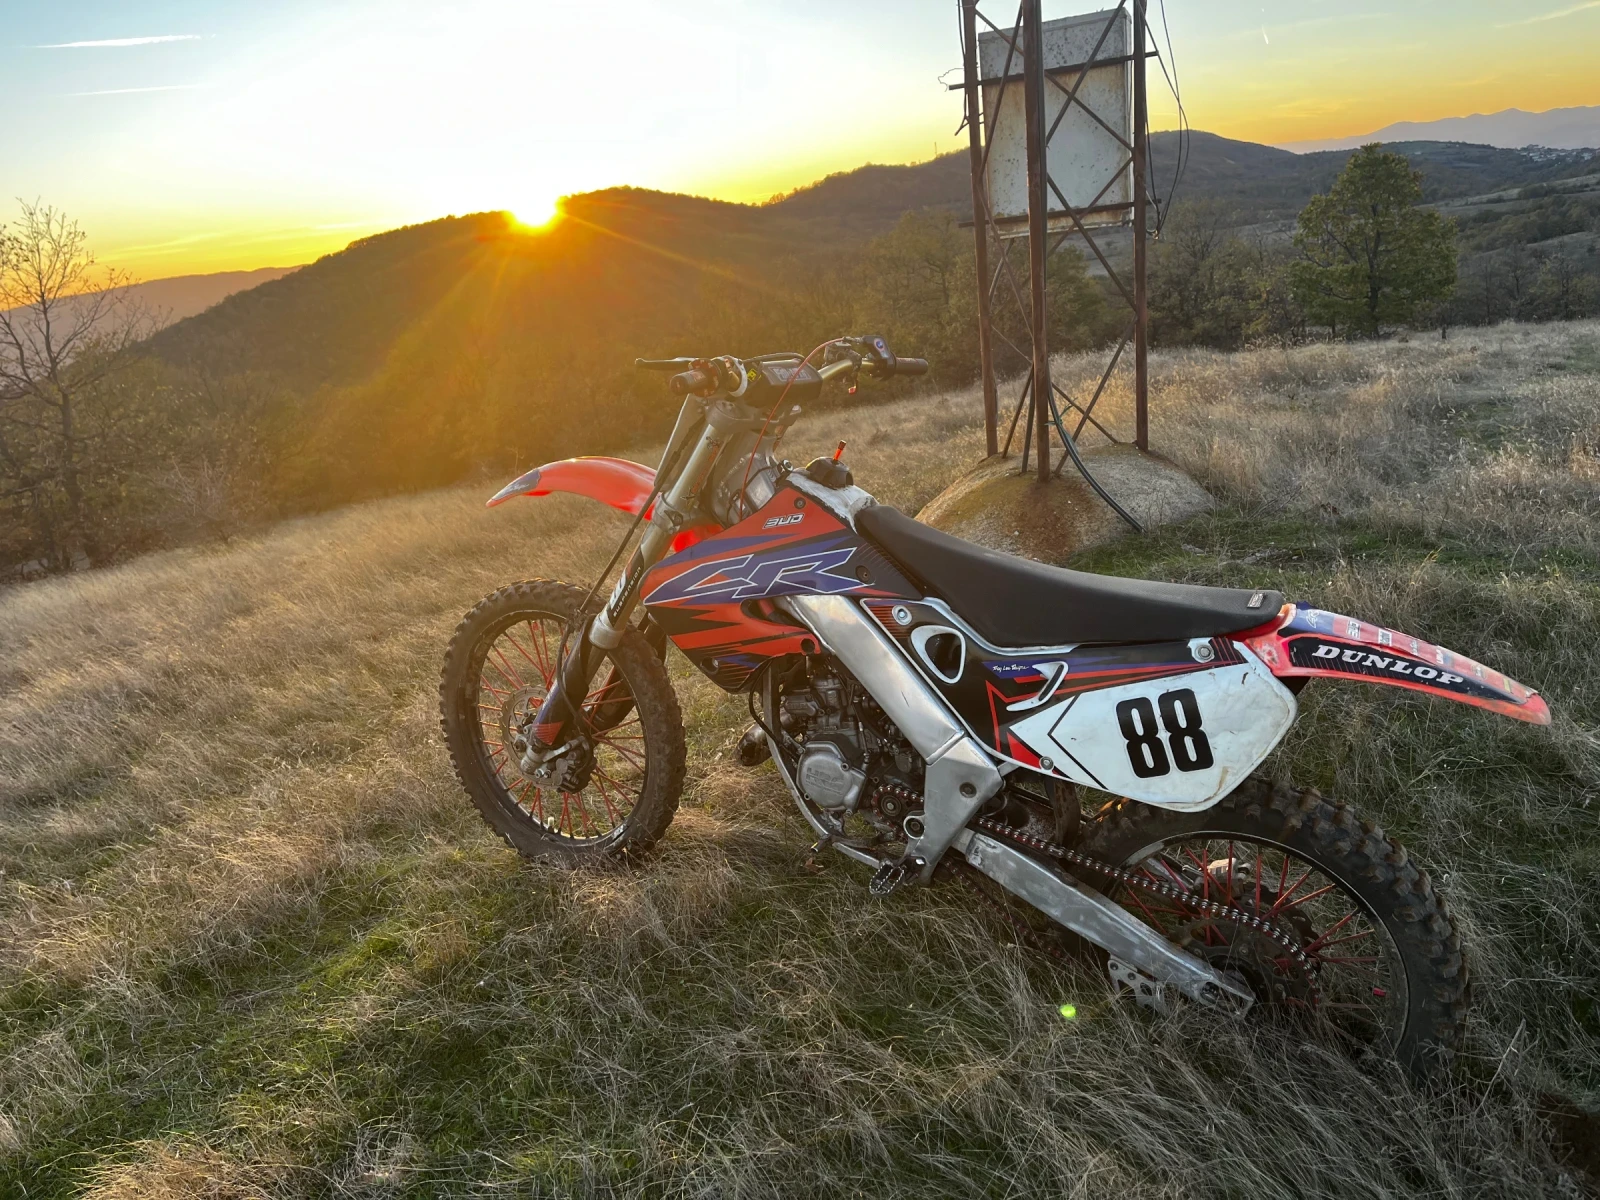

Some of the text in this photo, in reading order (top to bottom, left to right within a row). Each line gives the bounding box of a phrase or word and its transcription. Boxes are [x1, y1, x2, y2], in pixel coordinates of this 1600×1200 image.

[643, 547, 875, 605] CR
[1312, 644, 1464, 684] DUNLOP
[1115, 687, 1214, 778] 88
